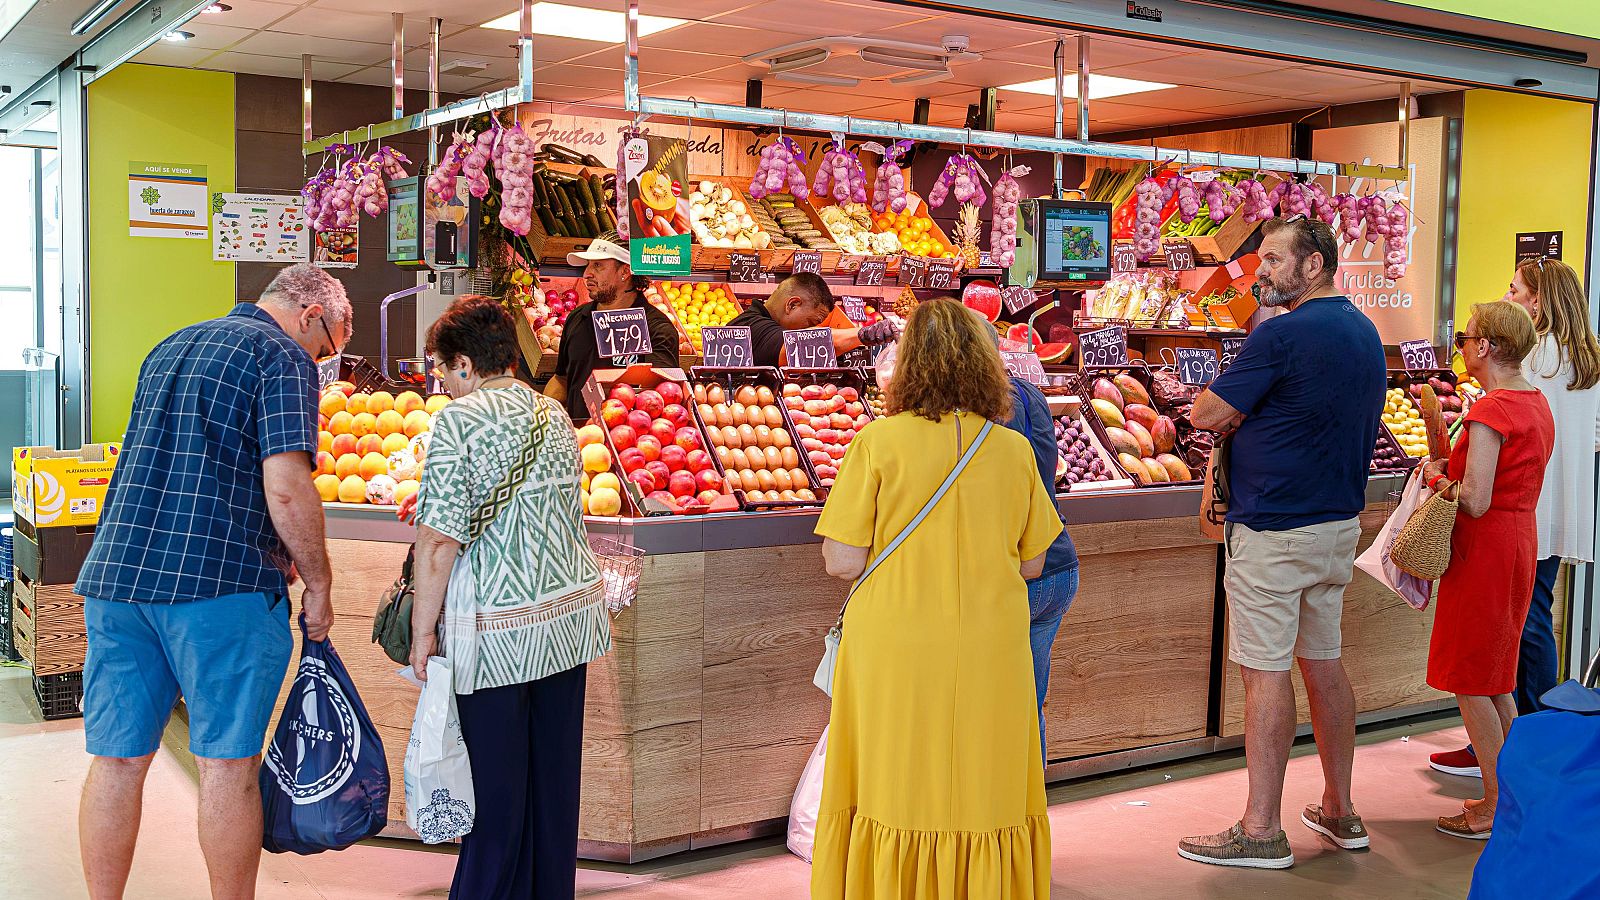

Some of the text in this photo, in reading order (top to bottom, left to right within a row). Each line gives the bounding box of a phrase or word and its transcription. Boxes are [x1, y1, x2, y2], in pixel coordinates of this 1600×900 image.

[531, 119, 606, 146] Frutas
[641, 254, 657, 264] DULCE
[1343, 271, 1396, 289] frutas
[1095, 329, 1115, 340] MANGO
